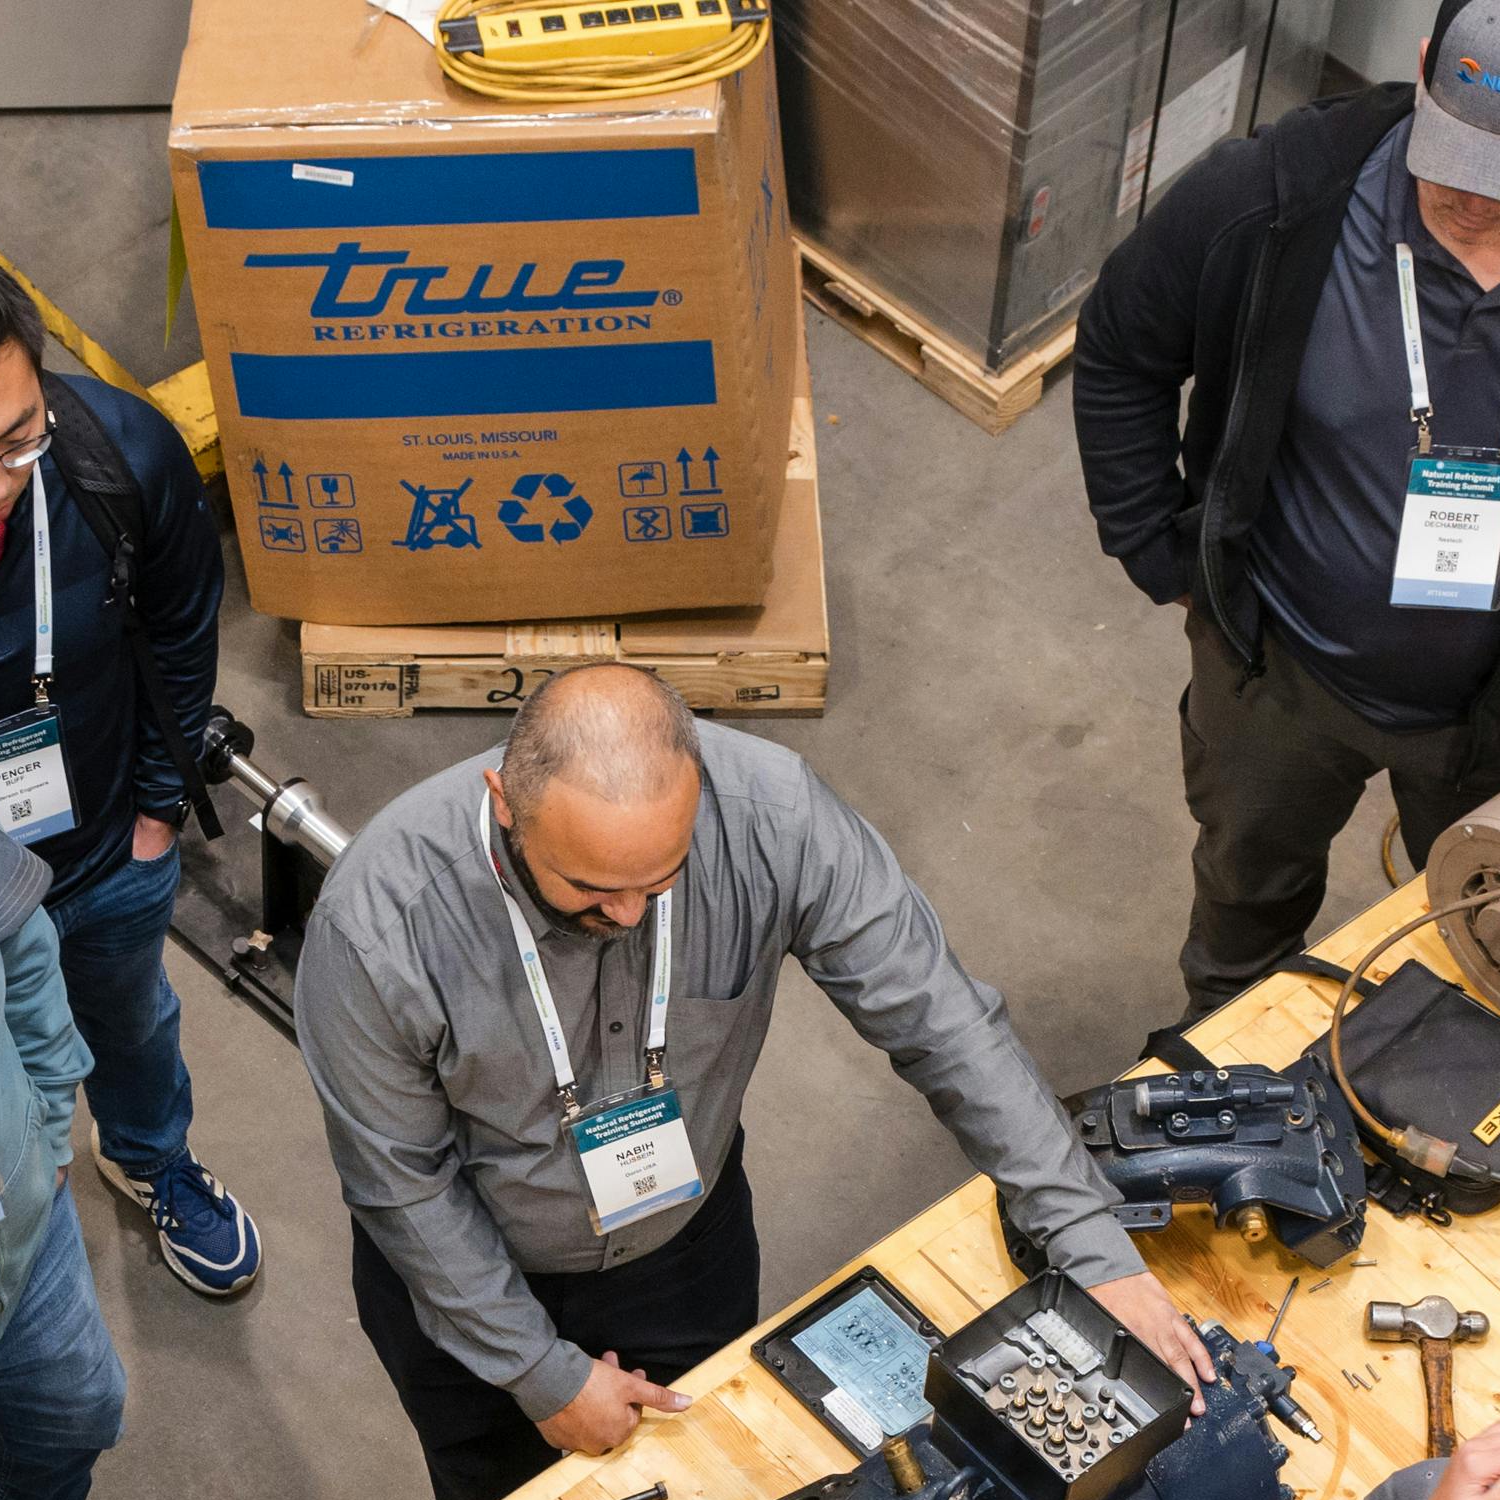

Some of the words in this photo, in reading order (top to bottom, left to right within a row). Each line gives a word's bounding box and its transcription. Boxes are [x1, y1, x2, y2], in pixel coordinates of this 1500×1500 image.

[243, 242, 660, 318] true
[312, 314, 652, 342] REFRIGERATION
[402, 434, 423, 446] ST.
[427, 432, 477, 446] LOUIS,
[480, 430, 558, 443] MISSOURI
[442, 451, 475, 461] MADE
[478, 451, 489, 460] IN
[1422, 469, 1453, 480] Natural
[1454, 471, 1500, 484] Refrigerant
[1427, 479, 1461, 490] Training
[1462, 482, 1494, 491] Summit
[1429, 511, 1479, 522] ROBERT
[1424, 520, 1479, 530] DECHAMBEAU
[344, 669, 371, 680] US-
[2, 729, 47, 748] Refrigerant
[12, 738, 43, 751] Summit
[584, 1118, 617, 1135] Natural
[617, 1102, 666, 1123] Refrigerant
[593, 1122, 629, 1140] Training
[628, 1111, 663, 1127] Summit
[615, 1140, 654, 1160] NABIH
[619, 1149, 655, 1166] HUSSEIN
